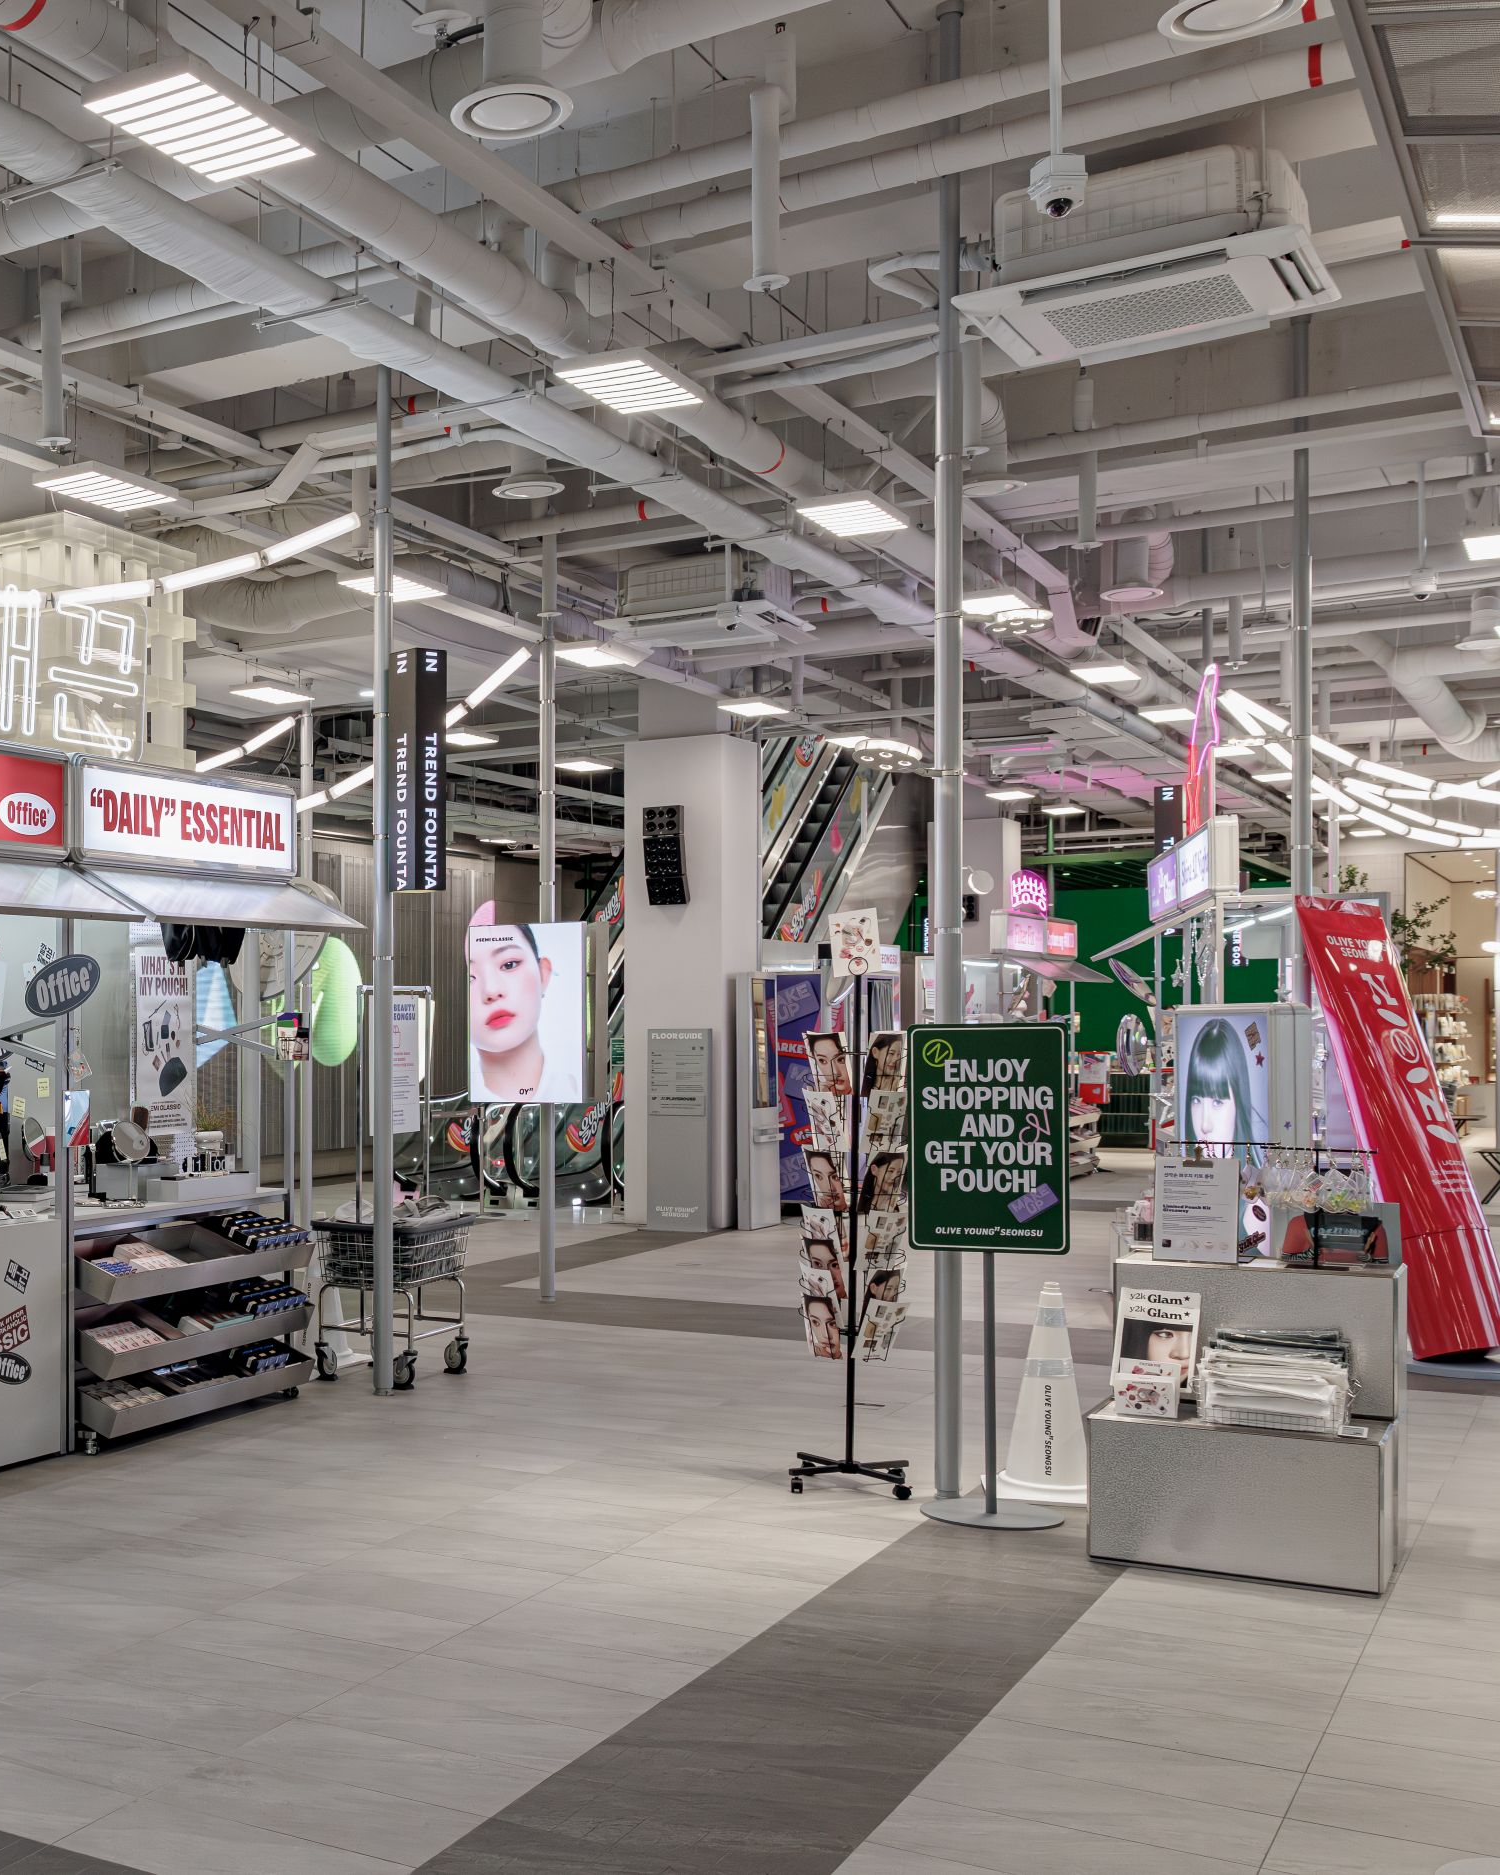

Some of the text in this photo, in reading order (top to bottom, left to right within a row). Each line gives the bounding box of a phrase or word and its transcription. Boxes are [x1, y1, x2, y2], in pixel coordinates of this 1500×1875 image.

[396, 652, 407, 890] IN TREND FOUNTA
[425, 651, 437, 890] IN TREND FOUNTA
[180, 801, 285, 852] ESSENTIAL
[1326, 935, 1354, 948] OLIVE
[139, 977, 188, 996] MY POUCH!
[393, 1003, 416, 1012] BEAUTY
[651, 1032, 702, 1040] FLOOR GUIDE
[944, 1058, 1030, 1083] ENJOY
[922, 1086, 1054, 1110] SHOPPING
[960, 1113, 1014, 1138] AND
[924, 1141, 1053, 1166] GET YOUR
[940, 1168, 1037, 1193] POUCH!
[935, 1226, 1043, 1238] OLIVE SEONGSU
[1147, 1293, 1183, 1305] Glam
[1147, 1308, 1182, 1320] Glam
